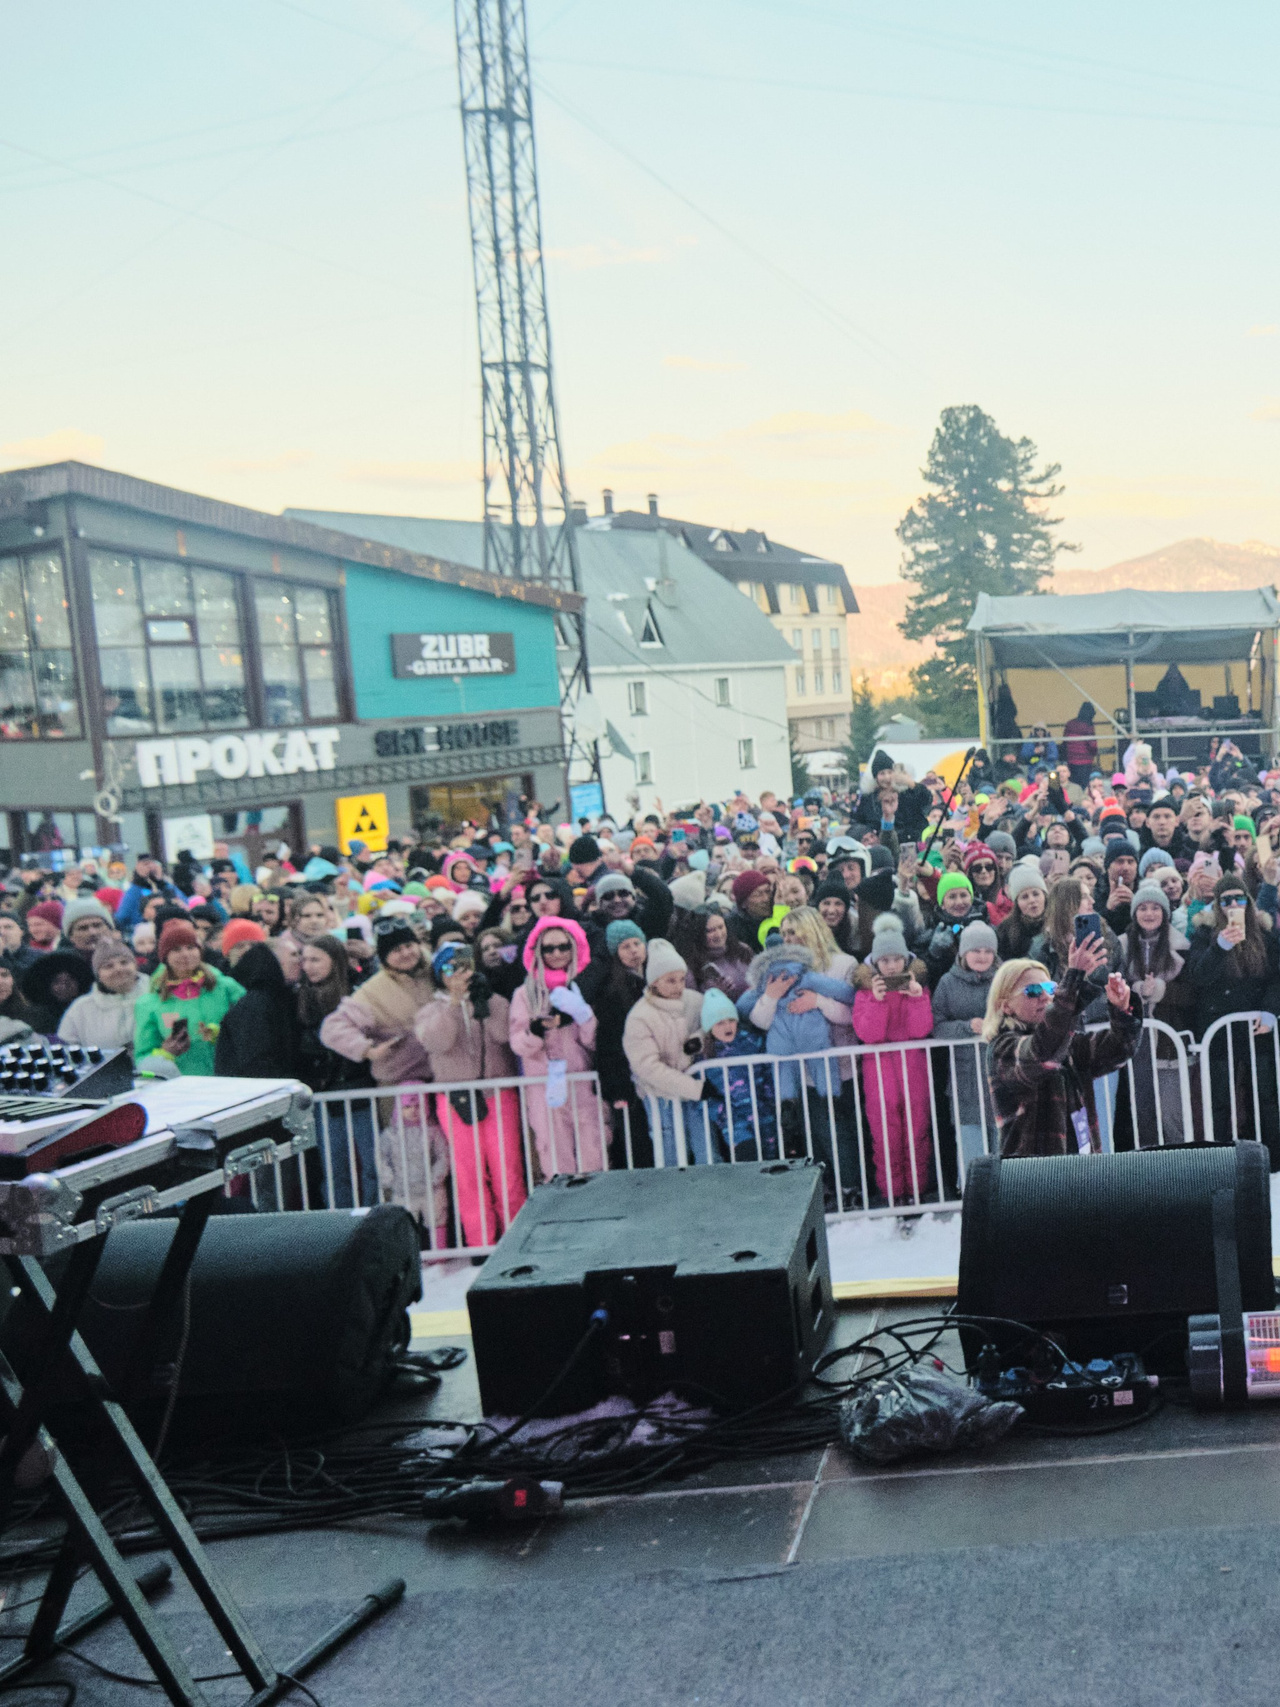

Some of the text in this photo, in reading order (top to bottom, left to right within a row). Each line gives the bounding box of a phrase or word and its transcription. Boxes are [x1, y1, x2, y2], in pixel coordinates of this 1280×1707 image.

[420, 634, 491, 659] ZUBR
[437, 718, 520, 752] HOUSE
[136, 727, 340, 788] ПРОКАТ
